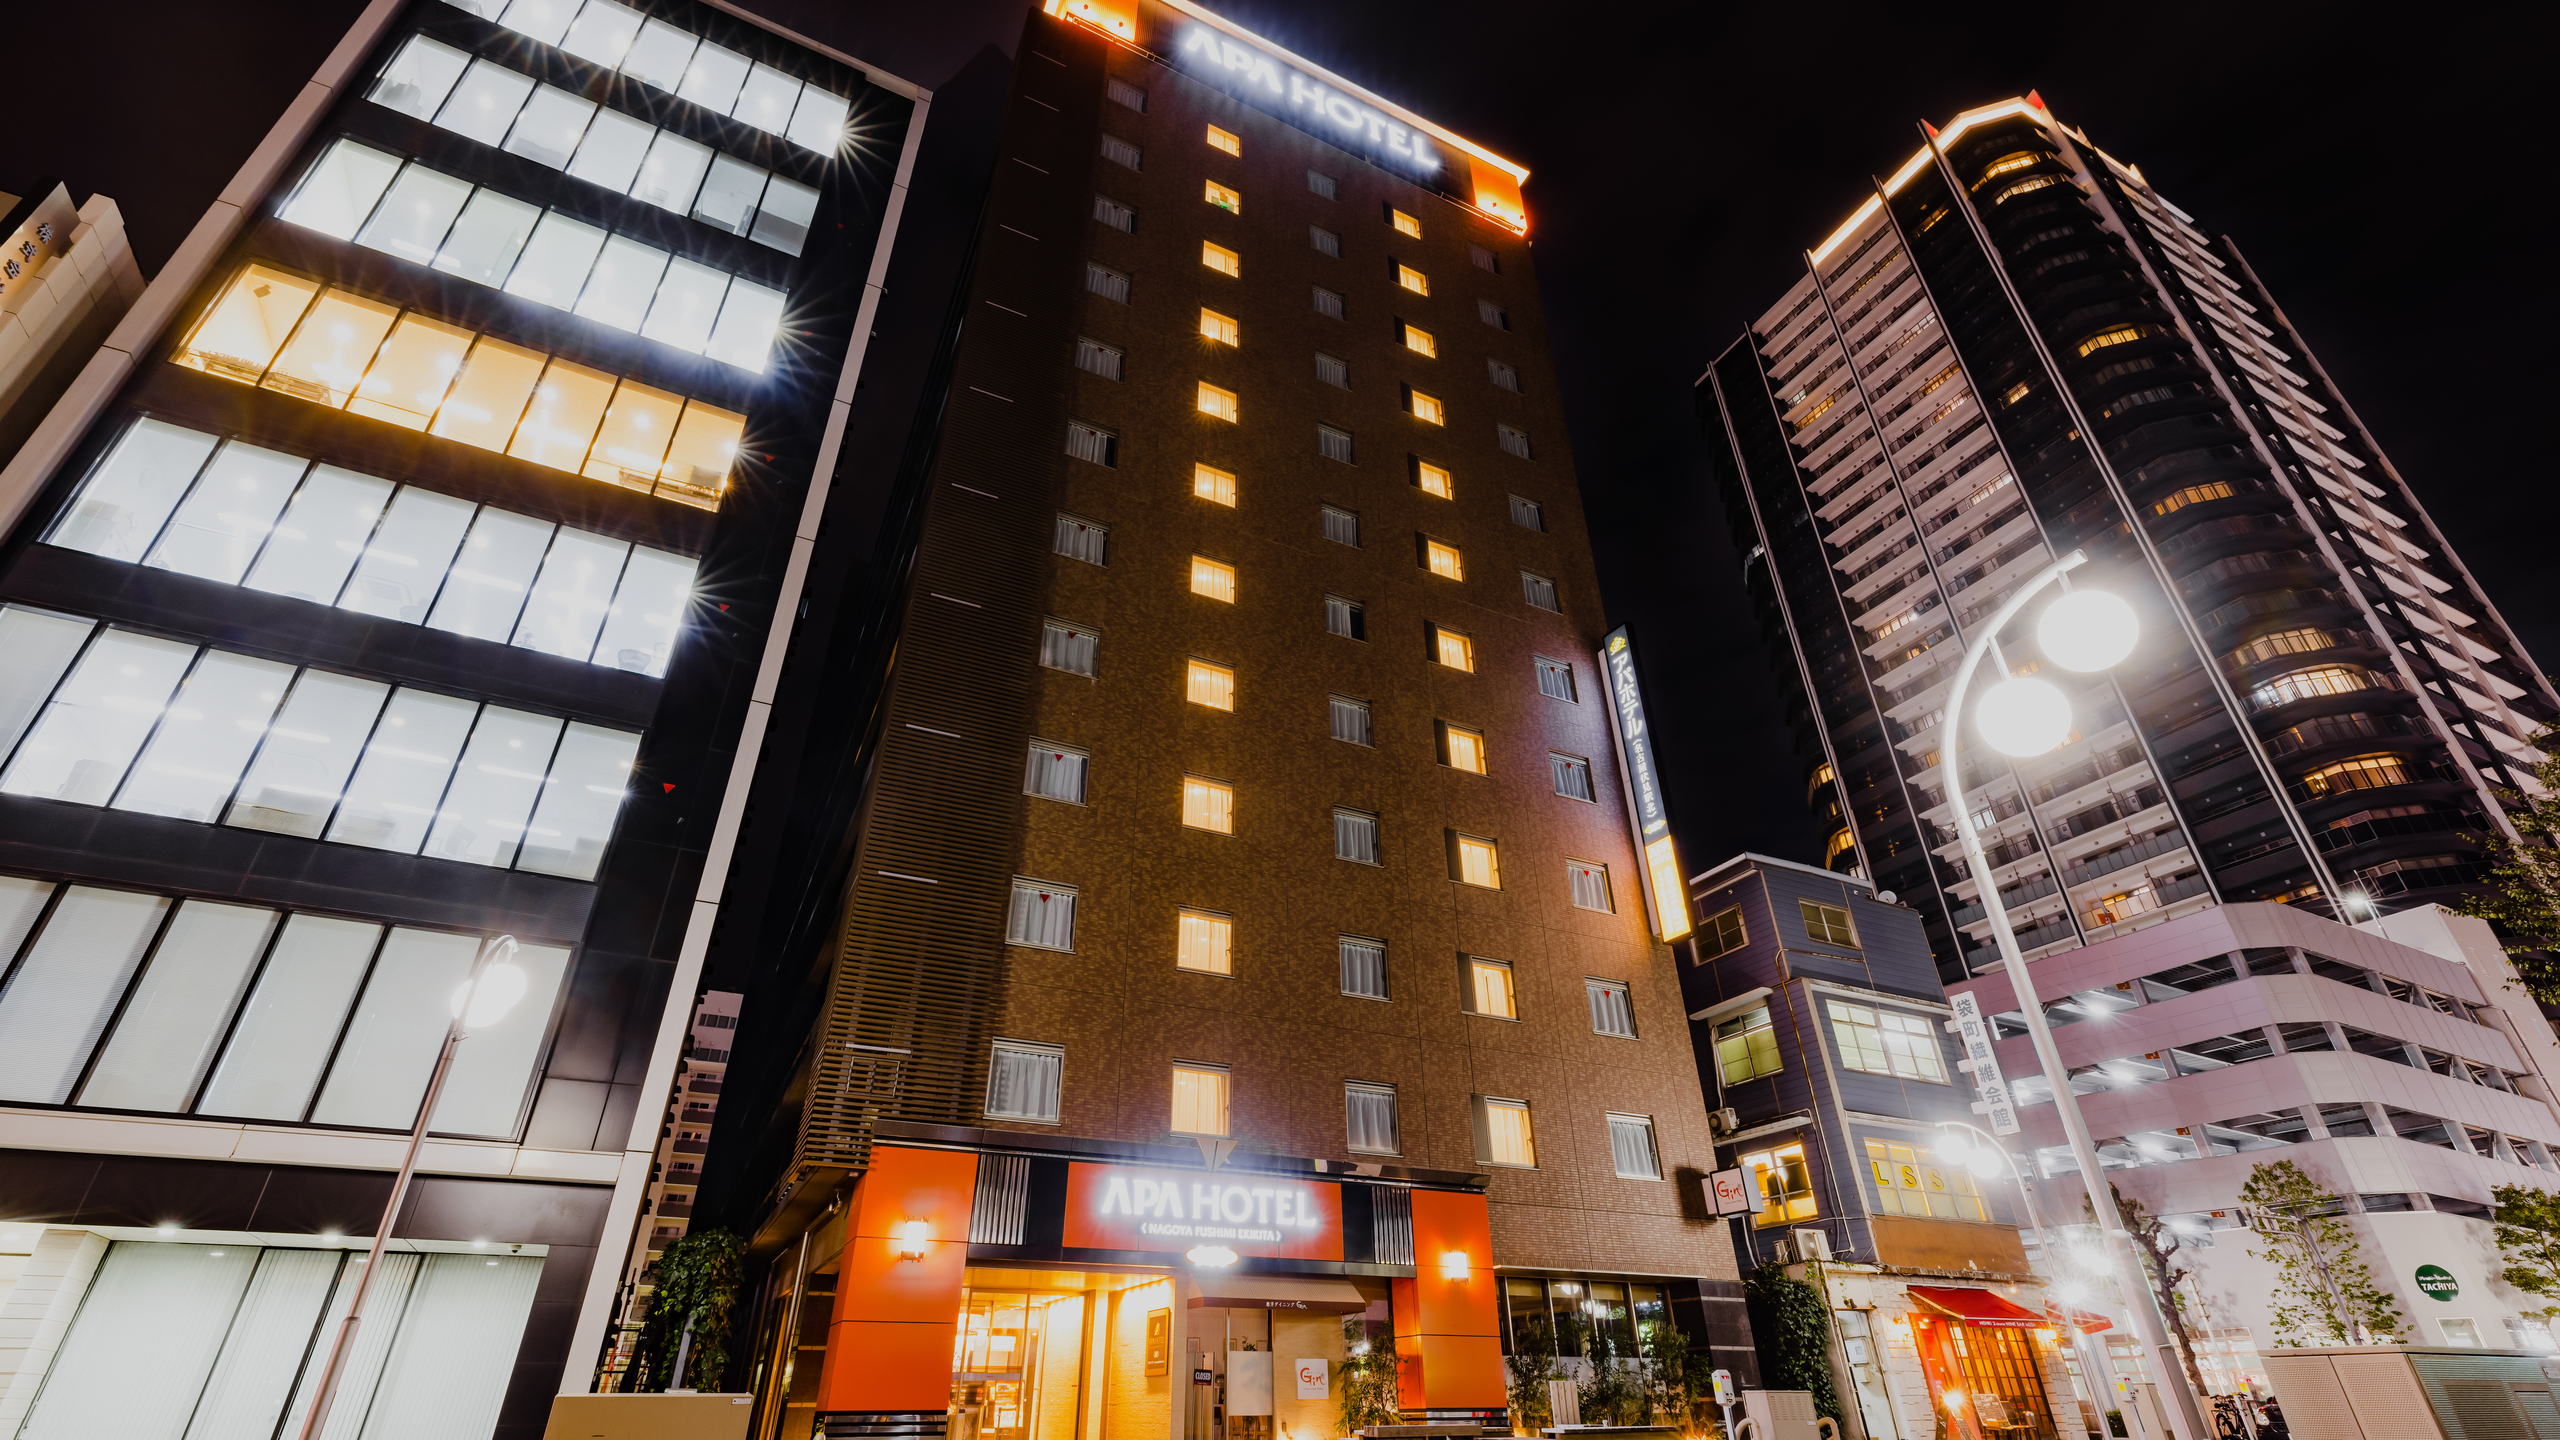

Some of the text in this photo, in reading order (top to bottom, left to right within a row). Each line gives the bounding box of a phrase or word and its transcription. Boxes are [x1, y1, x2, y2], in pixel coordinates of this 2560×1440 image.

[1186, 28, 1439, 168] APA HOTEL
[1612, 651, 1643, 739] アパホテル
[1716, 1180, 1744, 1200] Gin
[1101, 1177, 1317, 1227] APA HOTEL
[1195, 1226, 1236, 1239] FUSHIMI
[2420, 1282, 2458, 1291] TACHIYA
[1195, 1372, 1211, 1381] CLOSED
[1300, 1367, 1325, 1387] Gin
